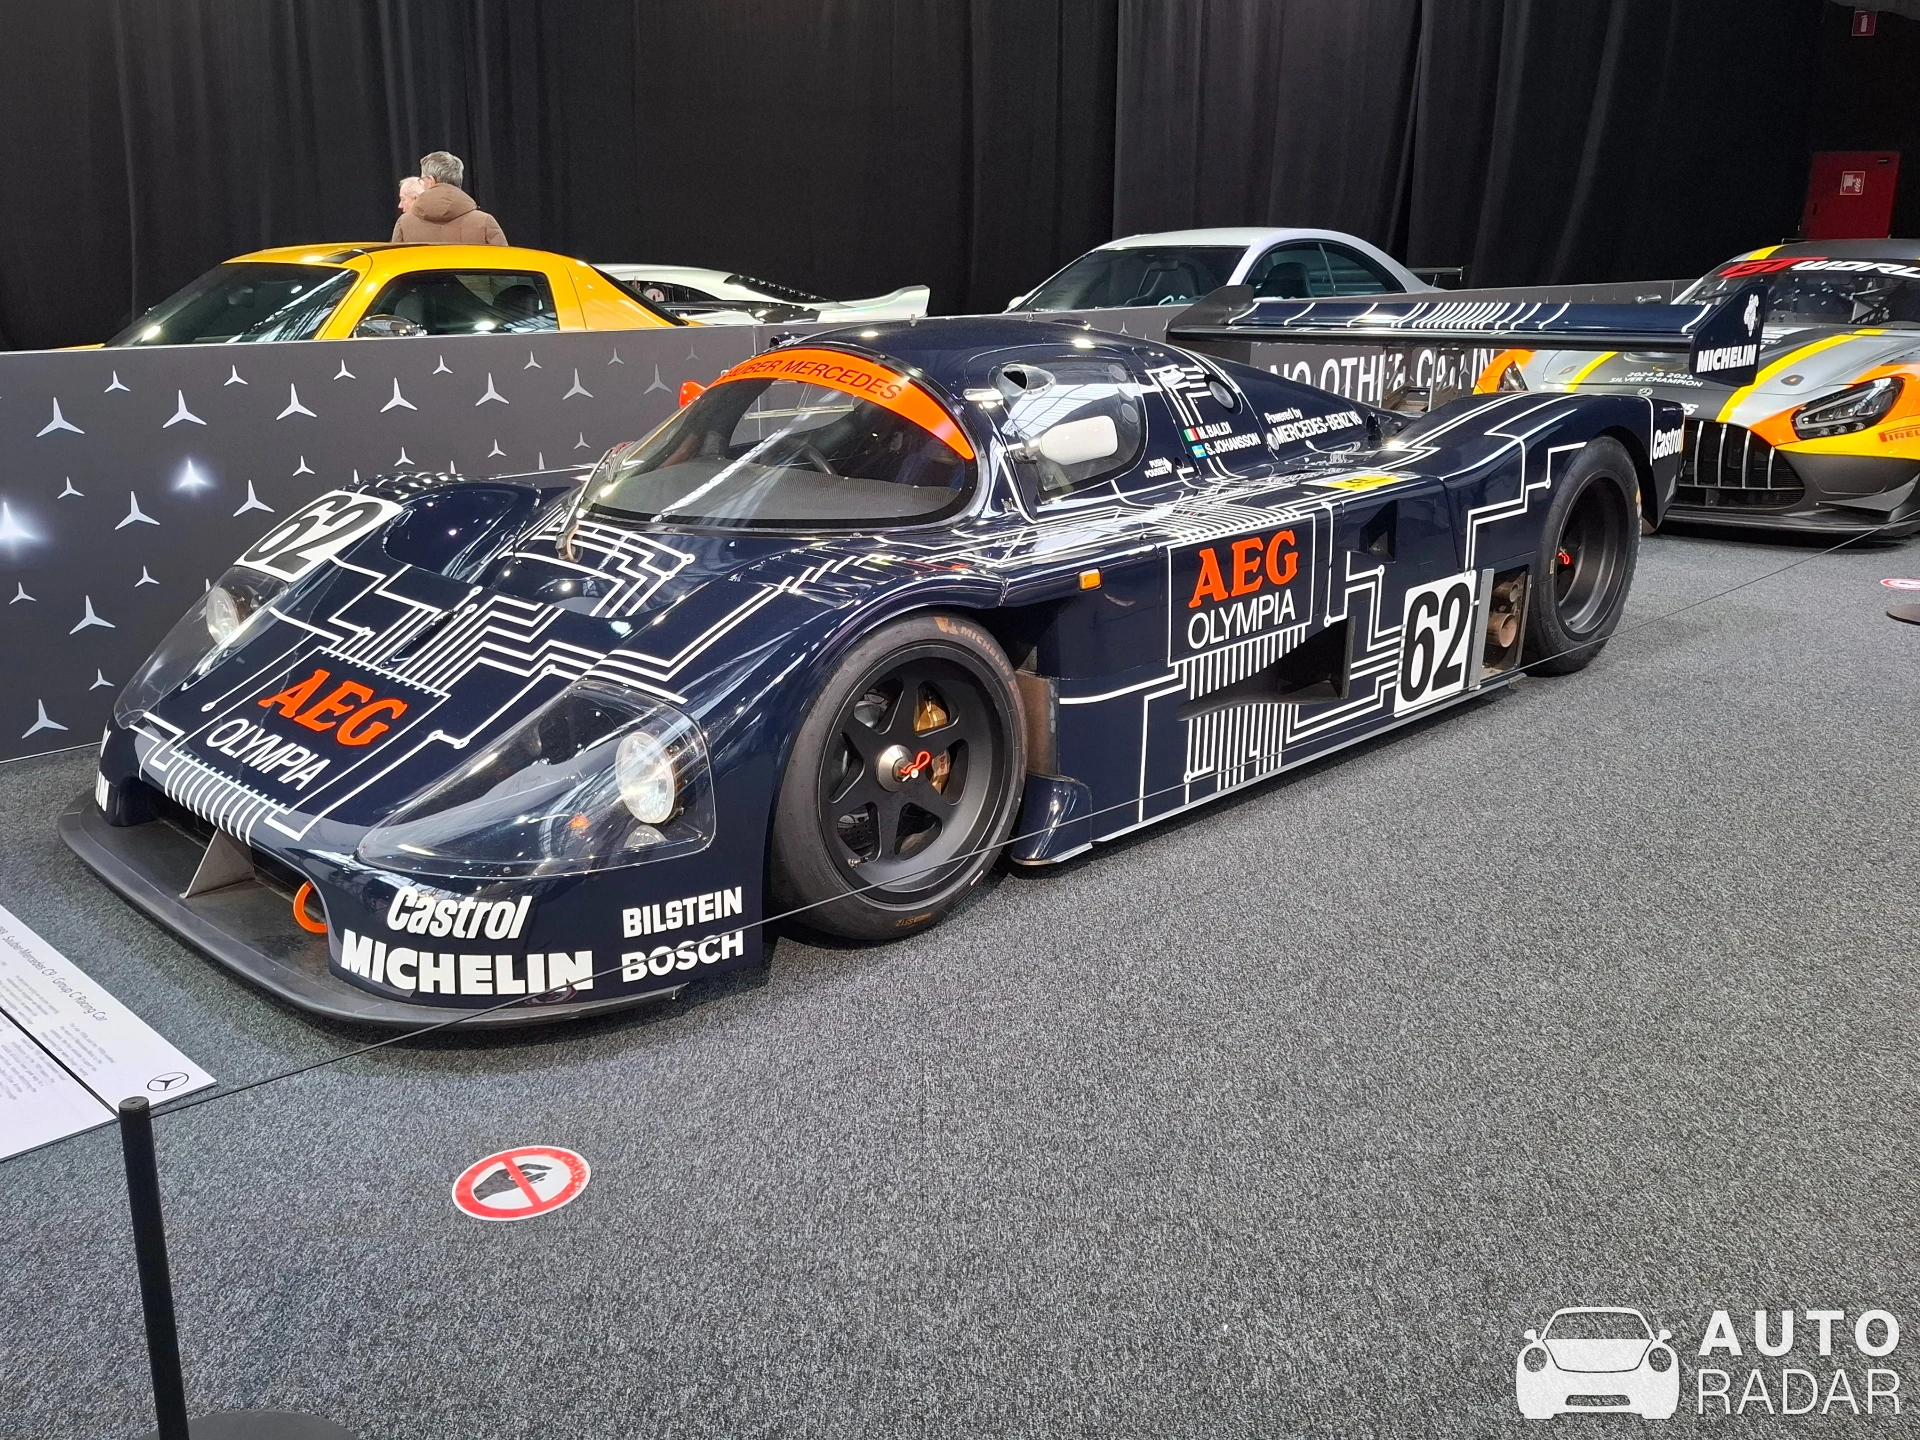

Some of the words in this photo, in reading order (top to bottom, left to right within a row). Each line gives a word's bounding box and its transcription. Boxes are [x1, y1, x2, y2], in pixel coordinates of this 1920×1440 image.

[780, 360, 903, 400] MERCEDES
[1645, 377, 1703, 388] CHAMPION
[1696, 344, 1757, 374] MICHELIN
[1264, 407, 1295, 424] Powered
[1291, 407, 1304, 420] by
[1272, 411, 1353, 444] MERCEDES-BENZ
[244, 494, 384, 575] 62
[1188, 529, 1299, 609] AEG
[1187, 588, 1296, 650] OLYMPIA
[1400, 581, 1470, 702] 62
[960, 626, 1011, 676] MICHELIN
[258, 668, 408, 746] AEG
[206, 718, 331, 791] OLYMPIA
[386, 885, 533, 940] Castrol
[622, 886, 743, 939] BILSTEIN
[340, 928, 595, 996] MICHELIN
[621, 929, 745, 984] BOSCH
[52, 977, 73, 994] Group
[75, 995, 97, 1015] Racing
[92, 1011, 108, 1022] Car
